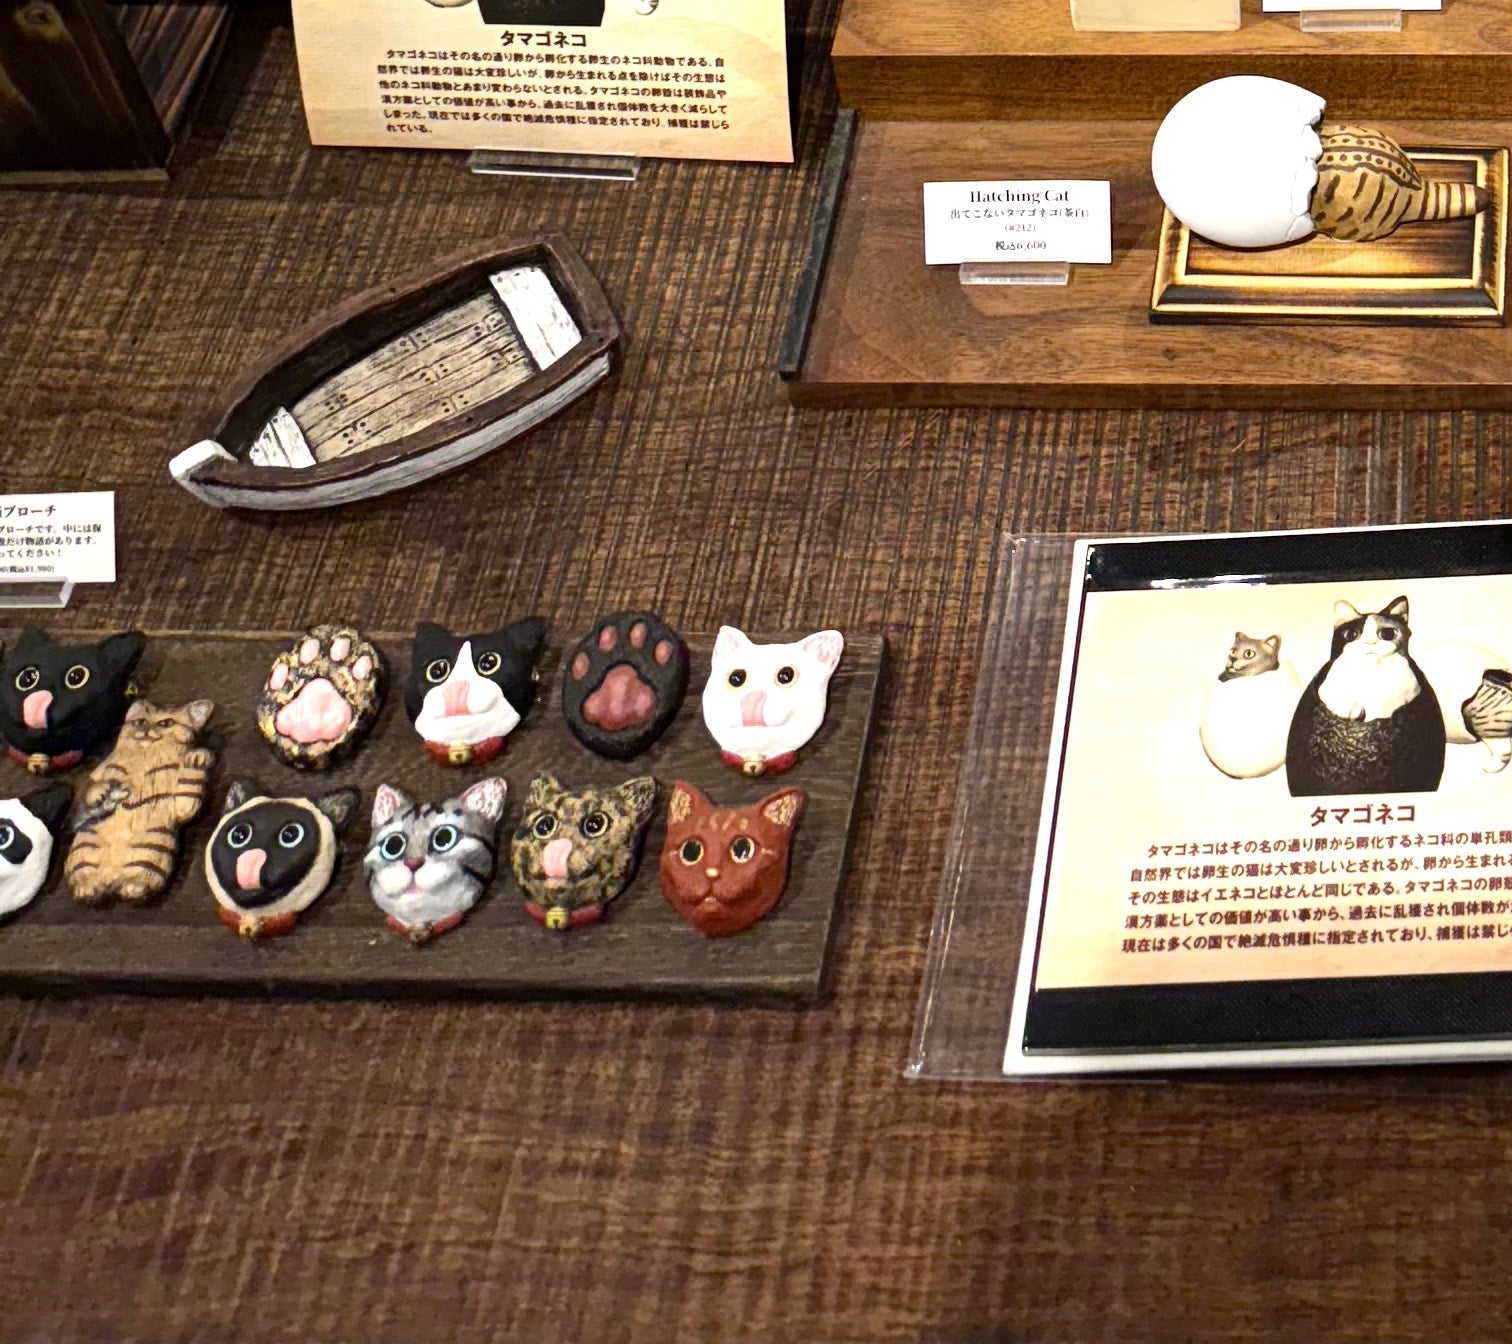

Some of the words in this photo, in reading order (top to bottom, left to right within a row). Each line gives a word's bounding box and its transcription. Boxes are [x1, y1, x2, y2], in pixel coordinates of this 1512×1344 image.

[501, 30, 587, 48] タマゴネコ
[386, 124, 432, 133] れている。
[970, 189, 1041, 204] Hatching
[1044, 189, 1069, 202] Cat
[0, 504, 56, 518] ブローチ
[1310, 804, 1416, 827] タマゴネコ
